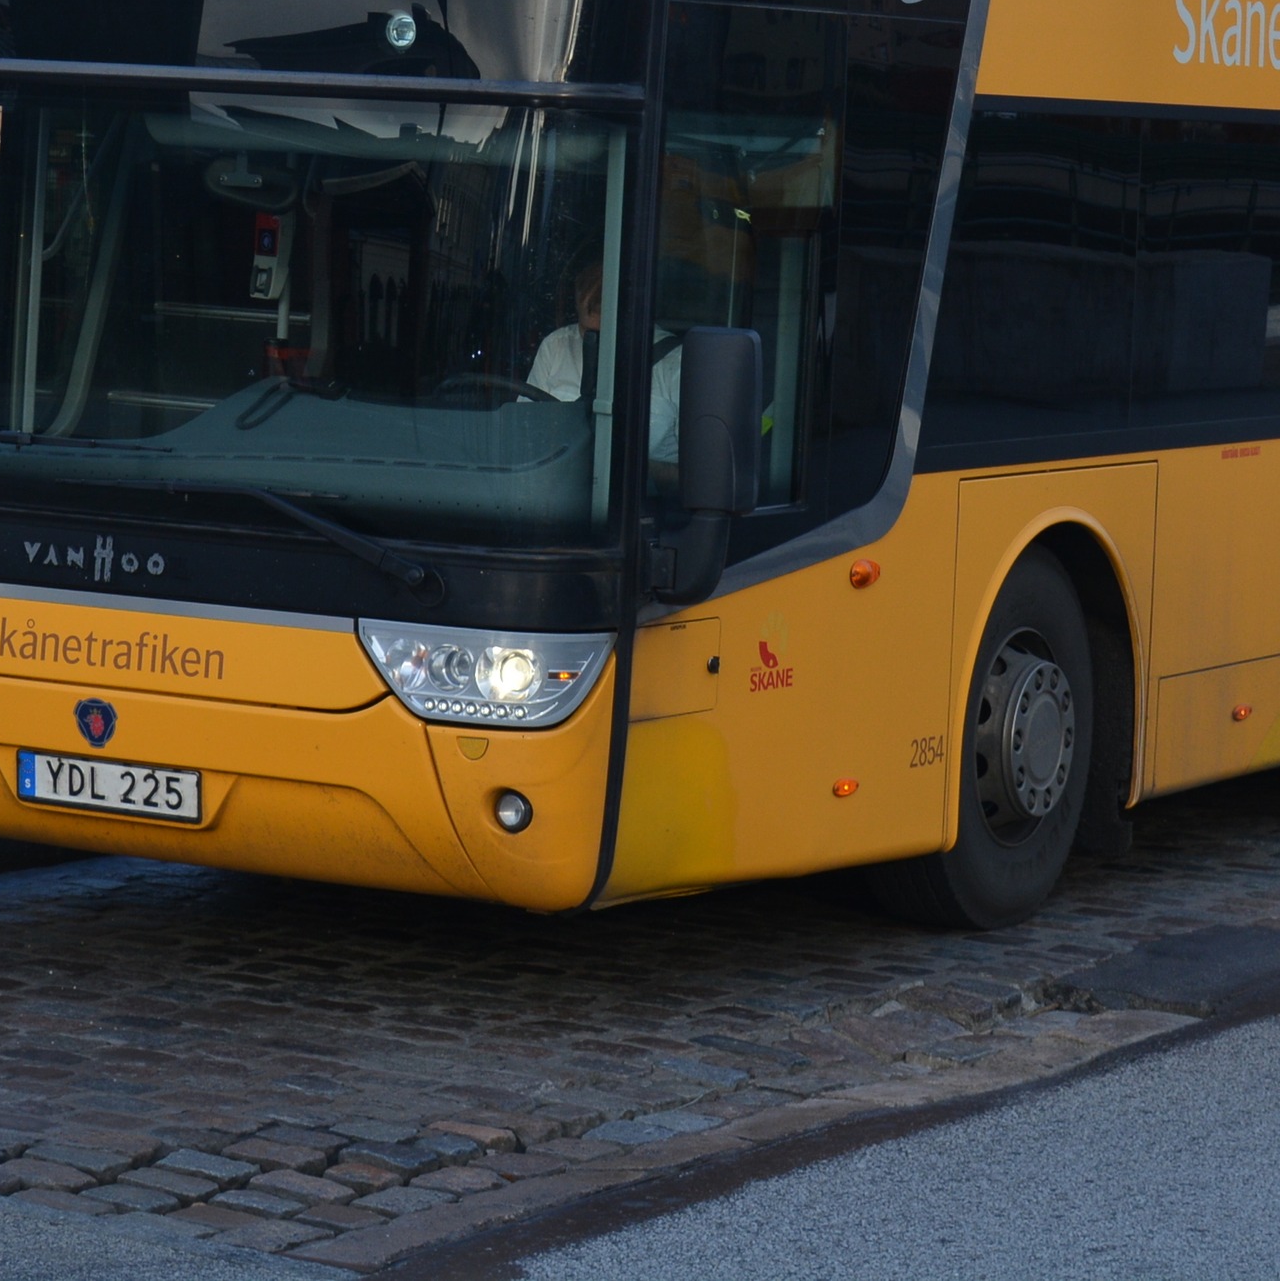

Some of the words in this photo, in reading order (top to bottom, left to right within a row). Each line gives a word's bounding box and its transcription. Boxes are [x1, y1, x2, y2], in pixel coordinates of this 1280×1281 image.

[910, 735, 944, 768] 2854
[46, 759, 106, 801] YDL
[120, 771, 183, 810] 225
